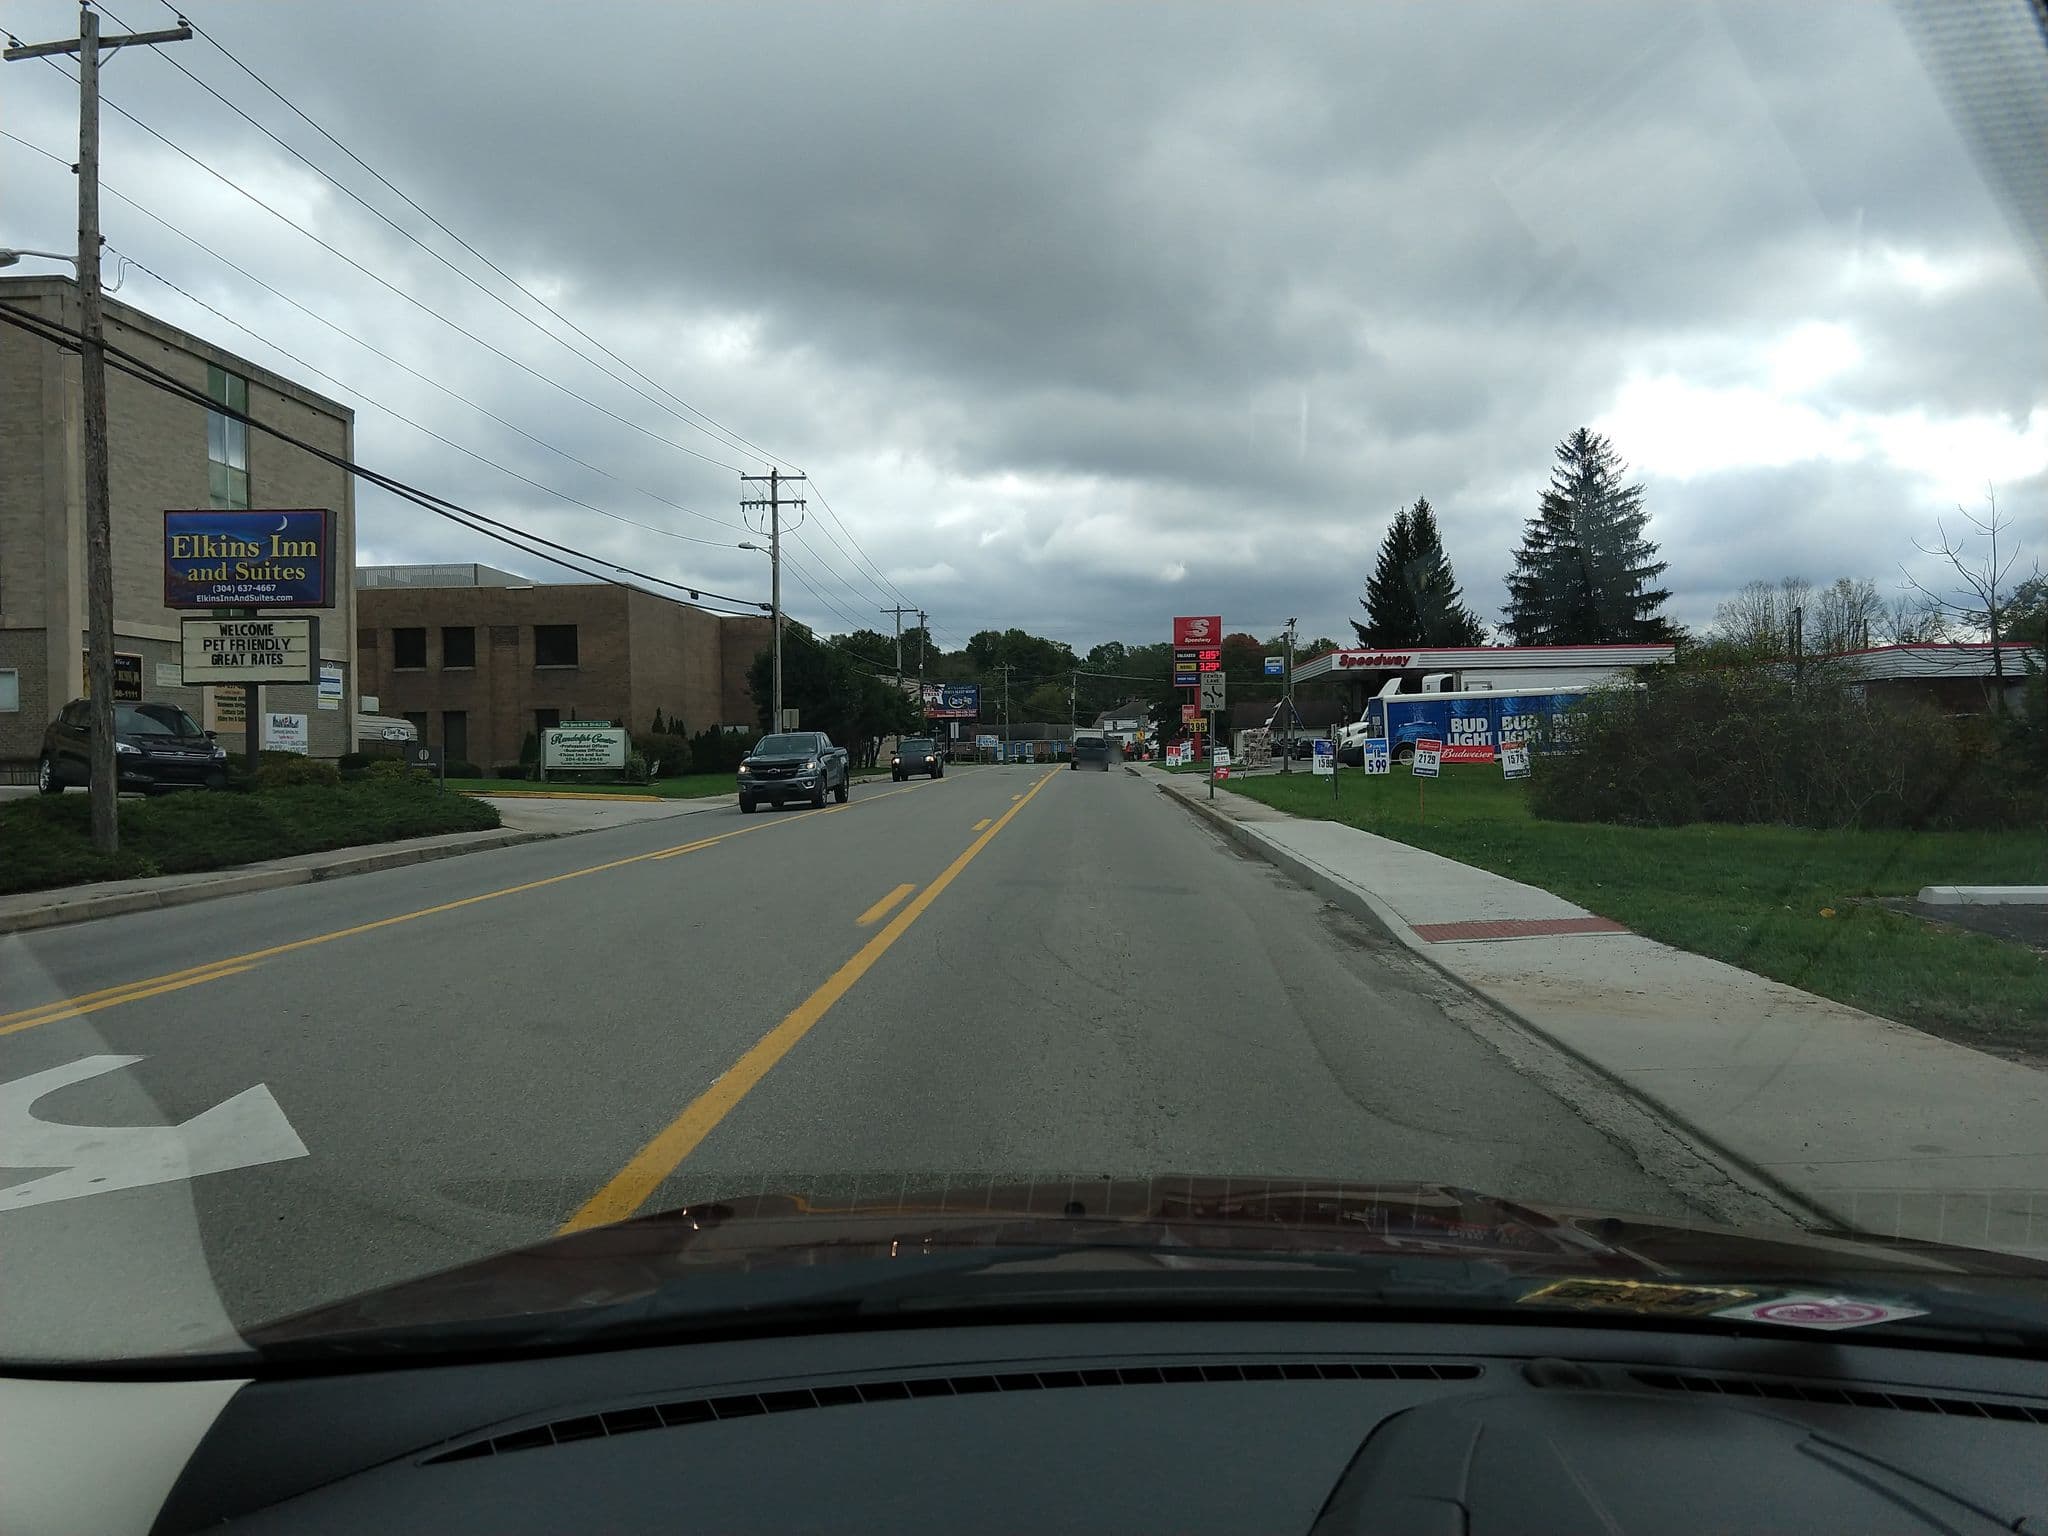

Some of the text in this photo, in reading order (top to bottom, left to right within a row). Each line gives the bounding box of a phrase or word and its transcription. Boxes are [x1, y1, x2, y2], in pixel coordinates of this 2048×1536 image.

[171, 534, 318, 558] Elkins Inn
[188, 561, 306, 581] and Suites
[212, 584, 277, 593] (304) 637-4667
[196, 594, 294, 602] ElkinsInnAndSuites.com
[219, 624, 274, 636] WELCOME
[203, 638, 291, 651] PET FRIENDLY
[211, 653, 283, 665] GREAT RATES
[1338, 653, 1411, 669] Speedway
[1450, 718, 1488, 732] BUD
[1501, 715, 1538, 730] BUD
[551, 734, 591, 745] Randolph
[1447, 732, 1493, 746] LIGHT
[1441, 748, 1493, 760] Budweiser
